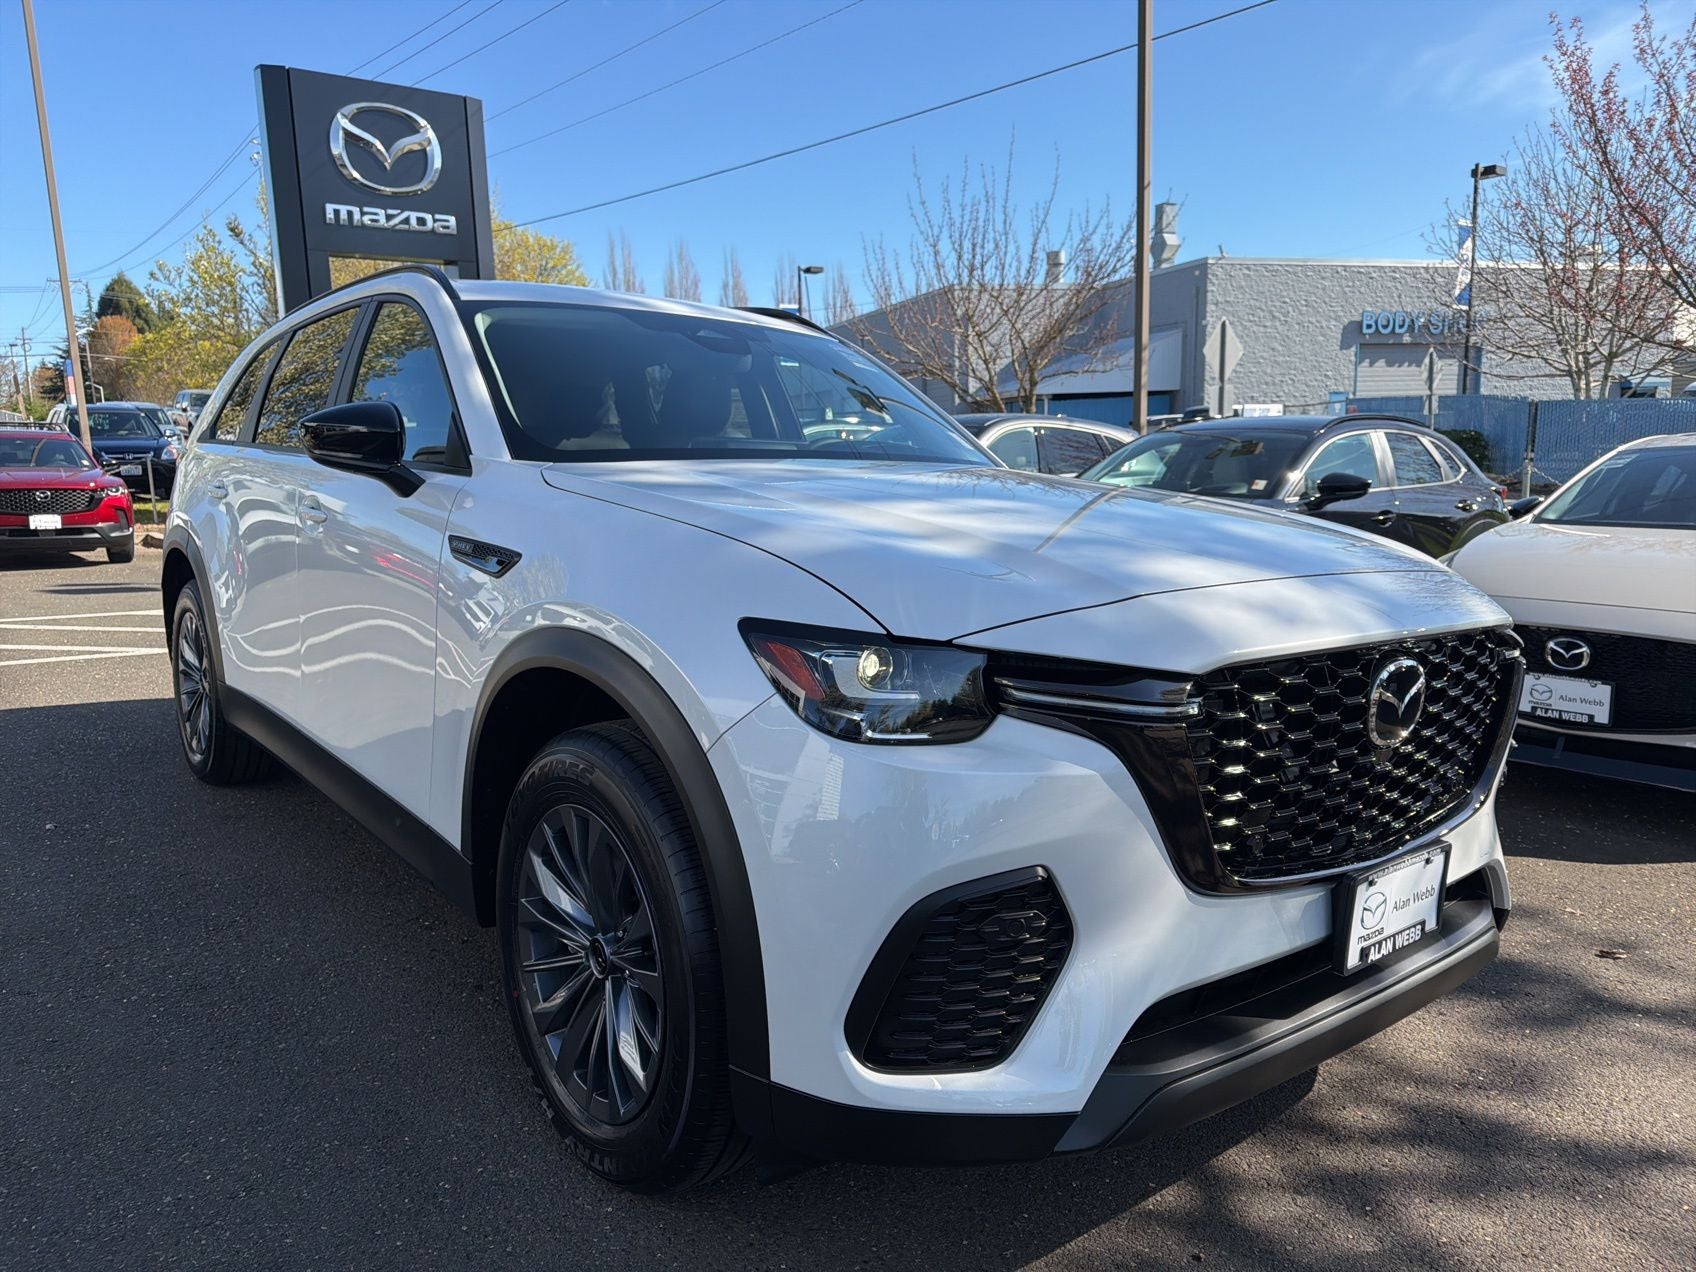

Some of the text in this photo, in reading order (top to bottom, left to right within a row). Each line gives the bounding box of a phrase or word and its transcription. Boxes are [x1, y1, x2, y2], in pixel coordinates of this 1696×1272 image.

[325, 202, 457, 235] mazda
[1361, 310, 1425, 335] BODY
[1559, 694, 1604, 707] Alan Webb
[1536, 707, 1589, 723] ALAN WEBB
[1392, 884, 1436, 914] Alan Webb
[1357, 927, 1385, 945] mazda
[1367, 923, 1422, 964] ALAN WEBB
